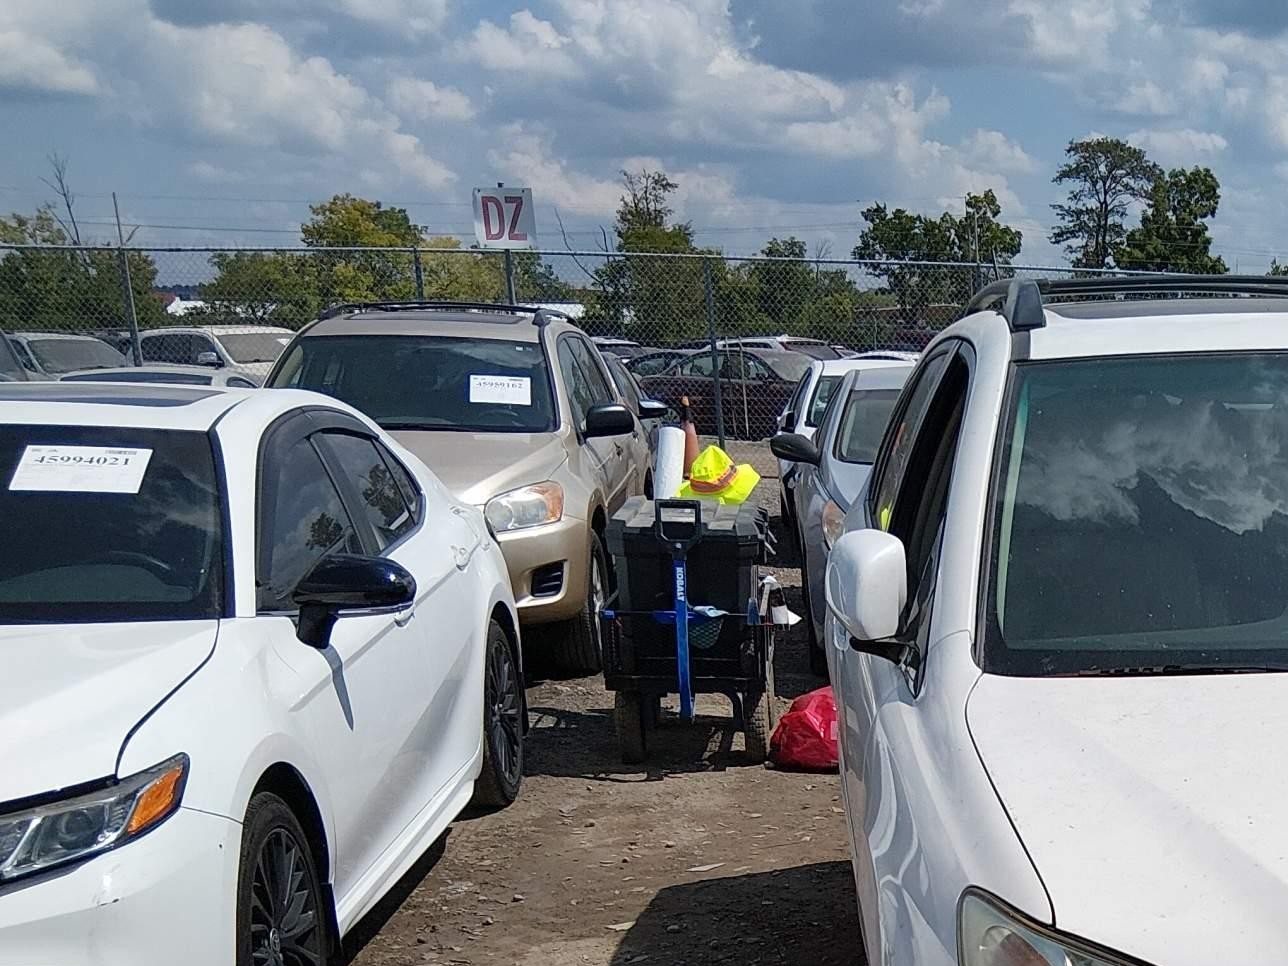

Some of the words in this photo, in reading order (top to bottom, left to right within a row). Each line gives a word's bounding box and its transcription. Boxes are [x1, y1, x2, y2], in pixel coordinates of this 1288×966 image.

[481, 195, 528, 241] DZ
[34, 455, 130, 465] 45994021
[675, 566, 685, 602] KOBALT
